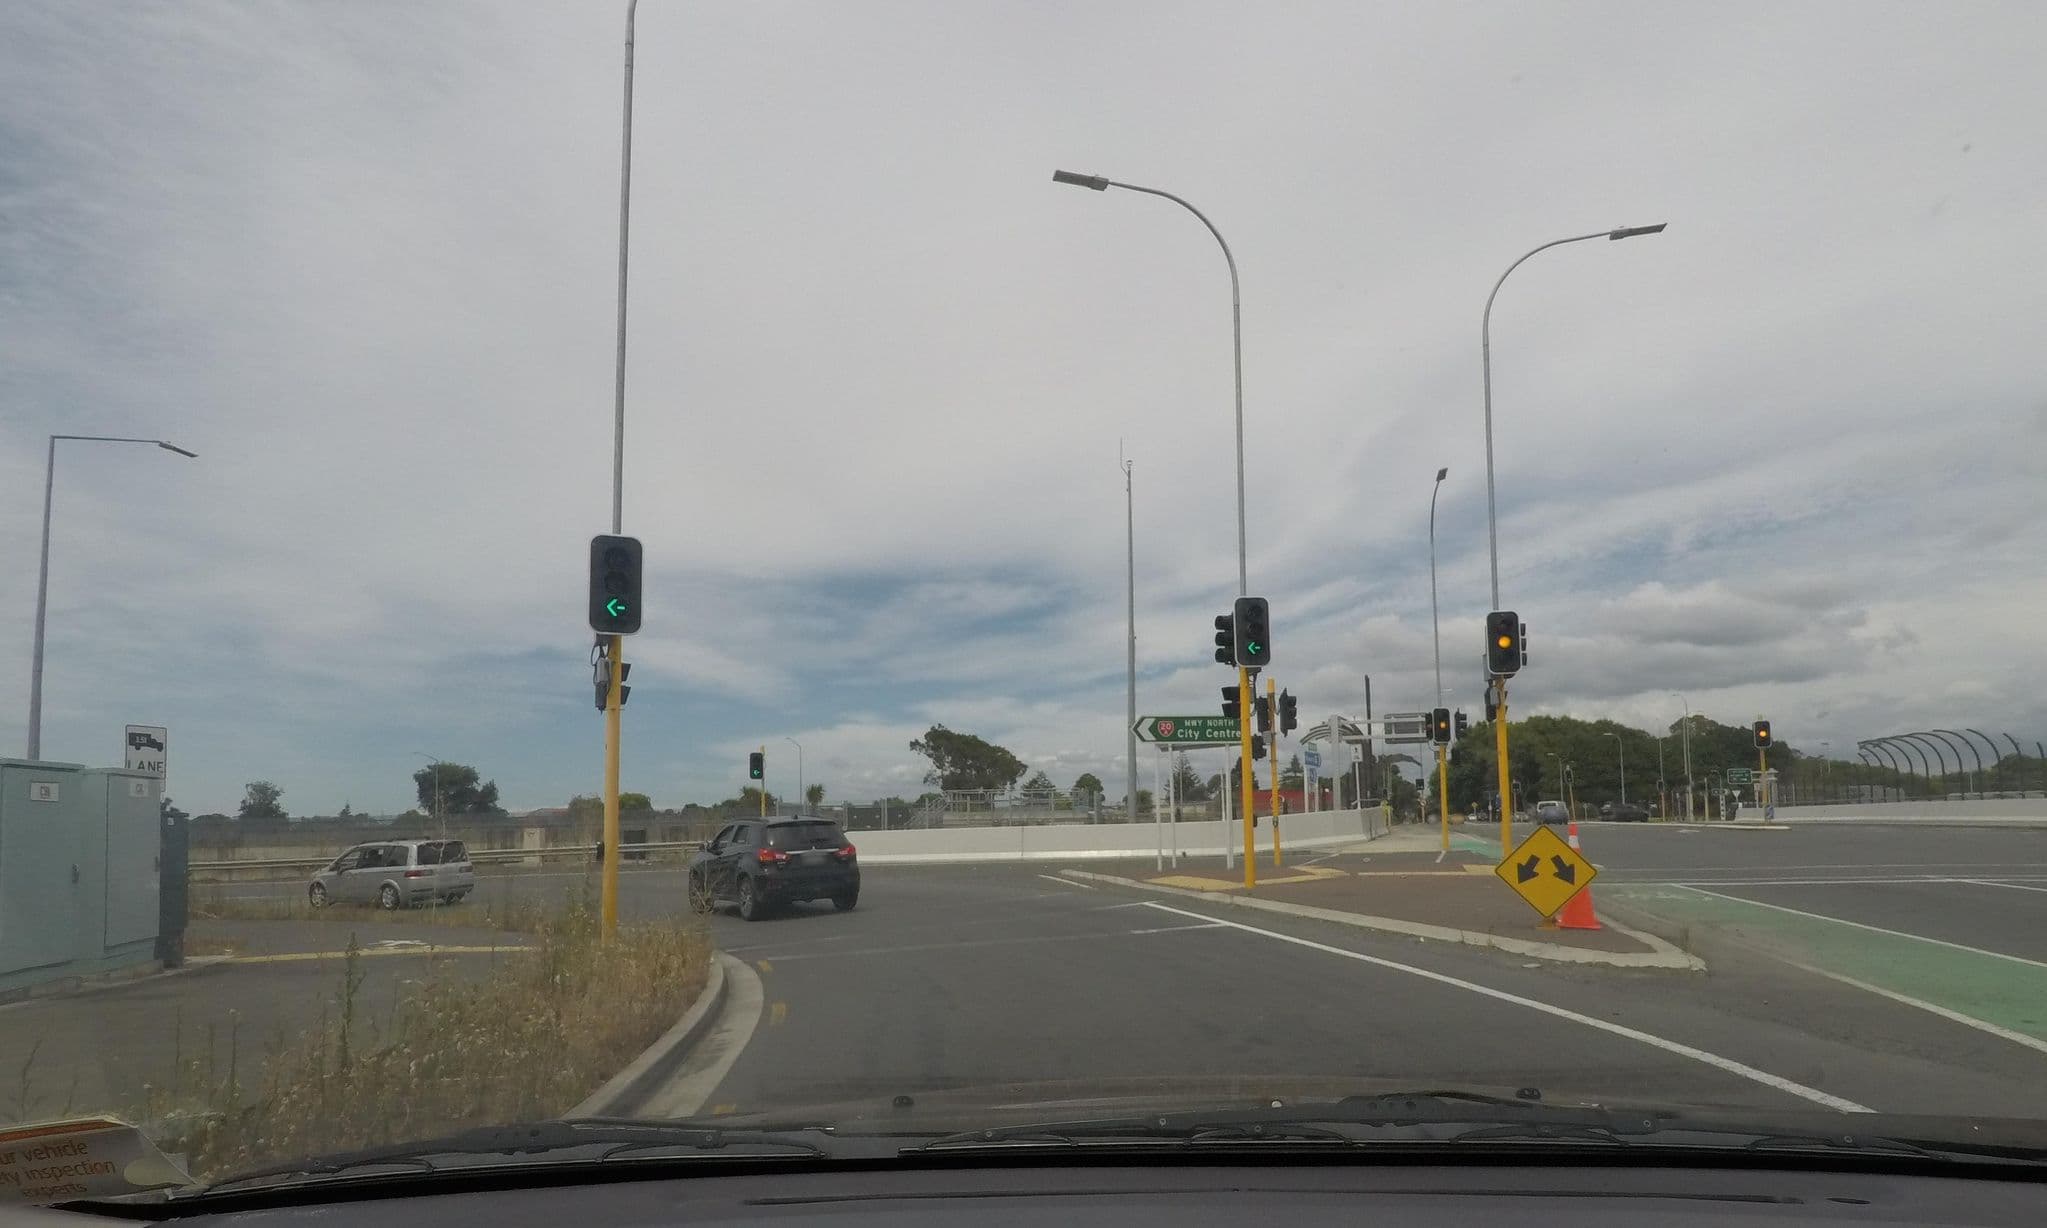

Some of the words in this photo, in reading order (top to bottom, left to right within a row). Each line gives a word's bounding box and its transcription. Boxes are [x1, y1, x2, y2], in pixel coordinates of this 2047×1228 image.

[1160, 722, 1172, 730] 20
[1177, 728, 1200, 739] City
[1205, 728, 1241, 737] Centre
[23, 1140, 88, 1161] vehicle
[25, 1159, 116, 1181] inspection
